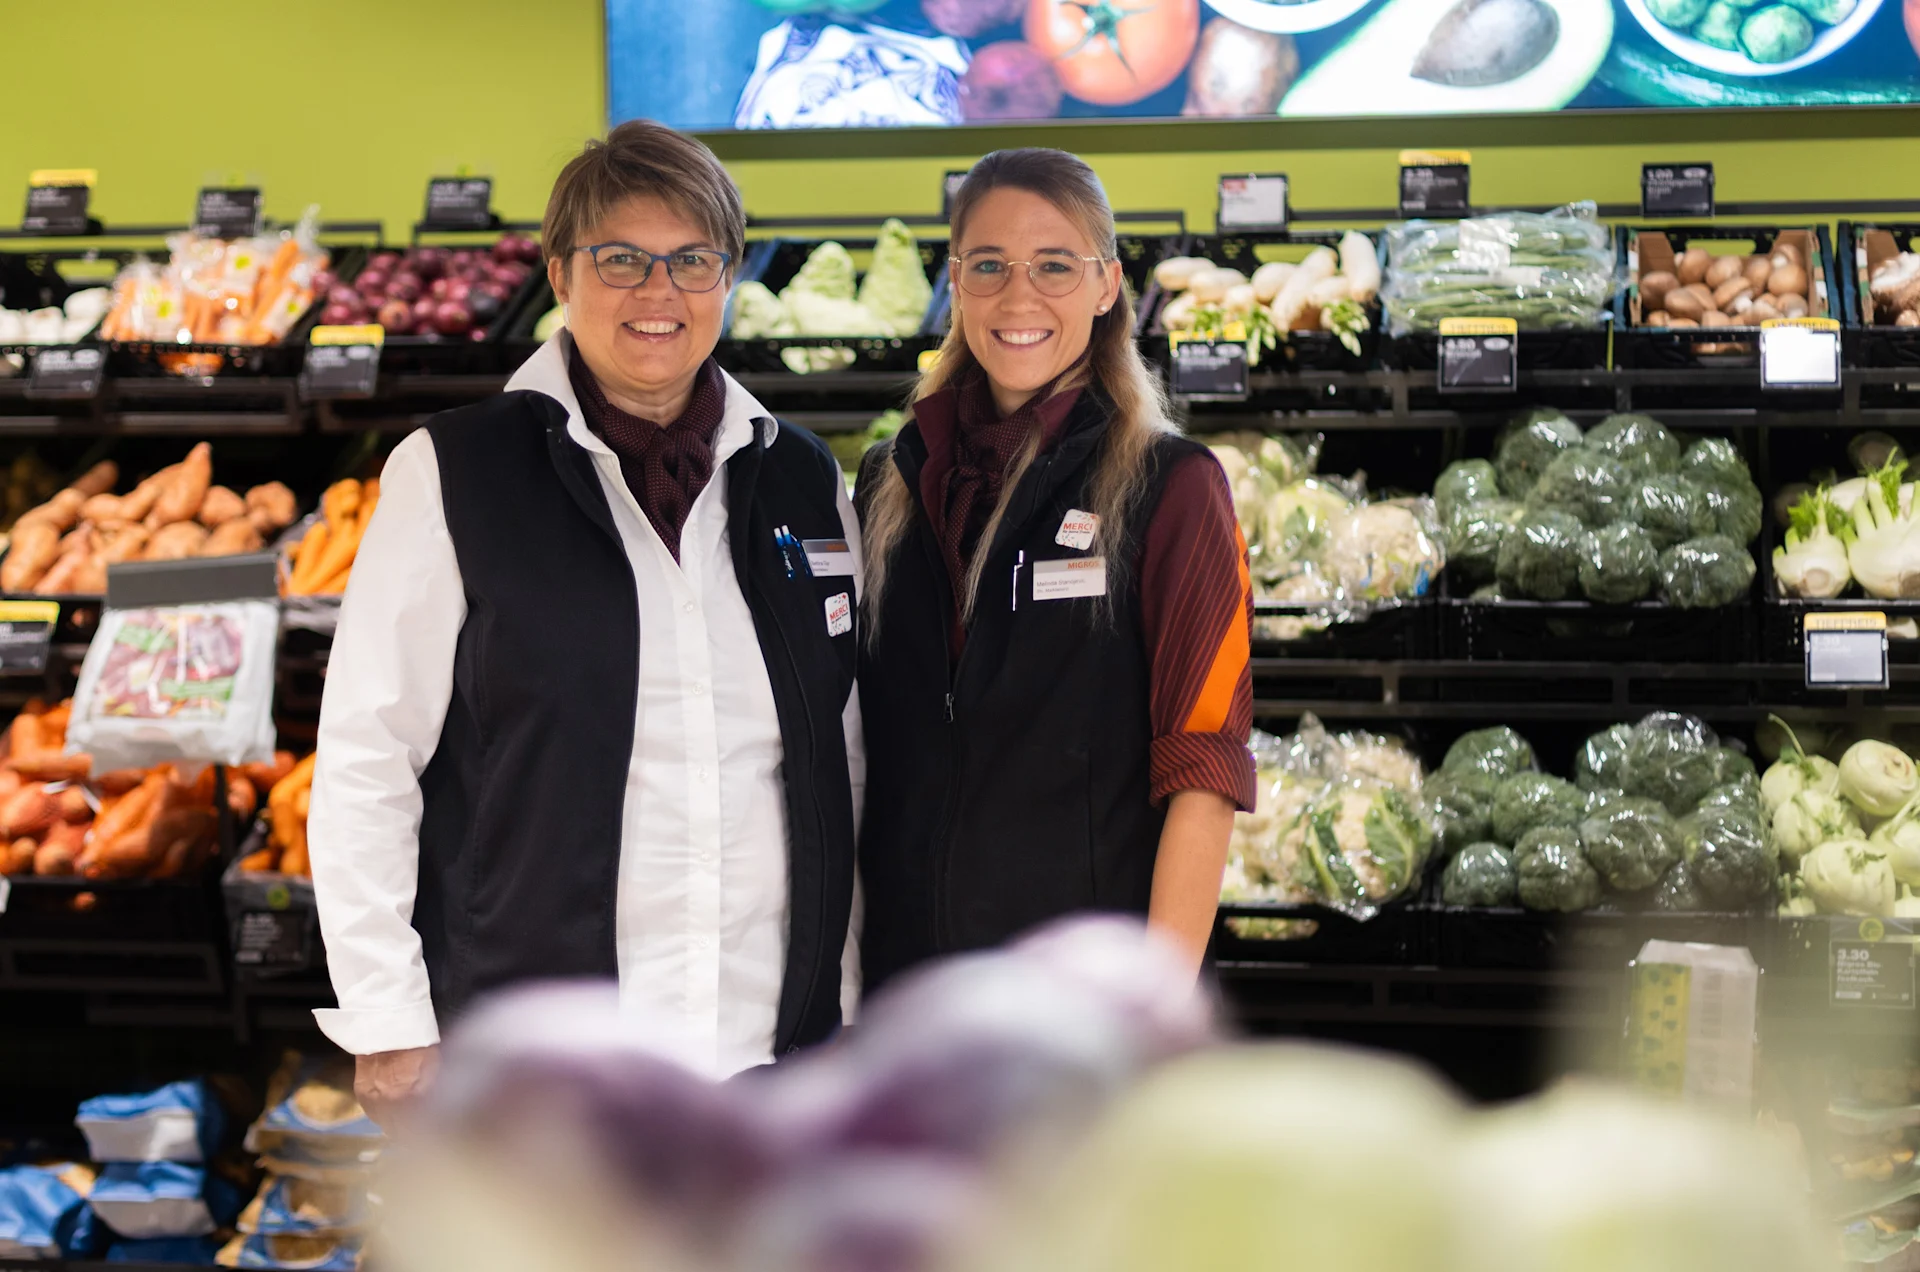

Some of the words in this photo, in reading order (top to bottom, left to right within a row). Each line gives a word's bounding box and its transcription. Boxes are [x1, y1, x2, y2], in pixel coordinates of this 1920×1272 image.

[1063, 522, 1093, 531] MERCI
[1067, 561, 1100, 570] MIGROS
[829, 603, 849, 621] MERCI
[1838, 948, 1870, 961] 3.30
